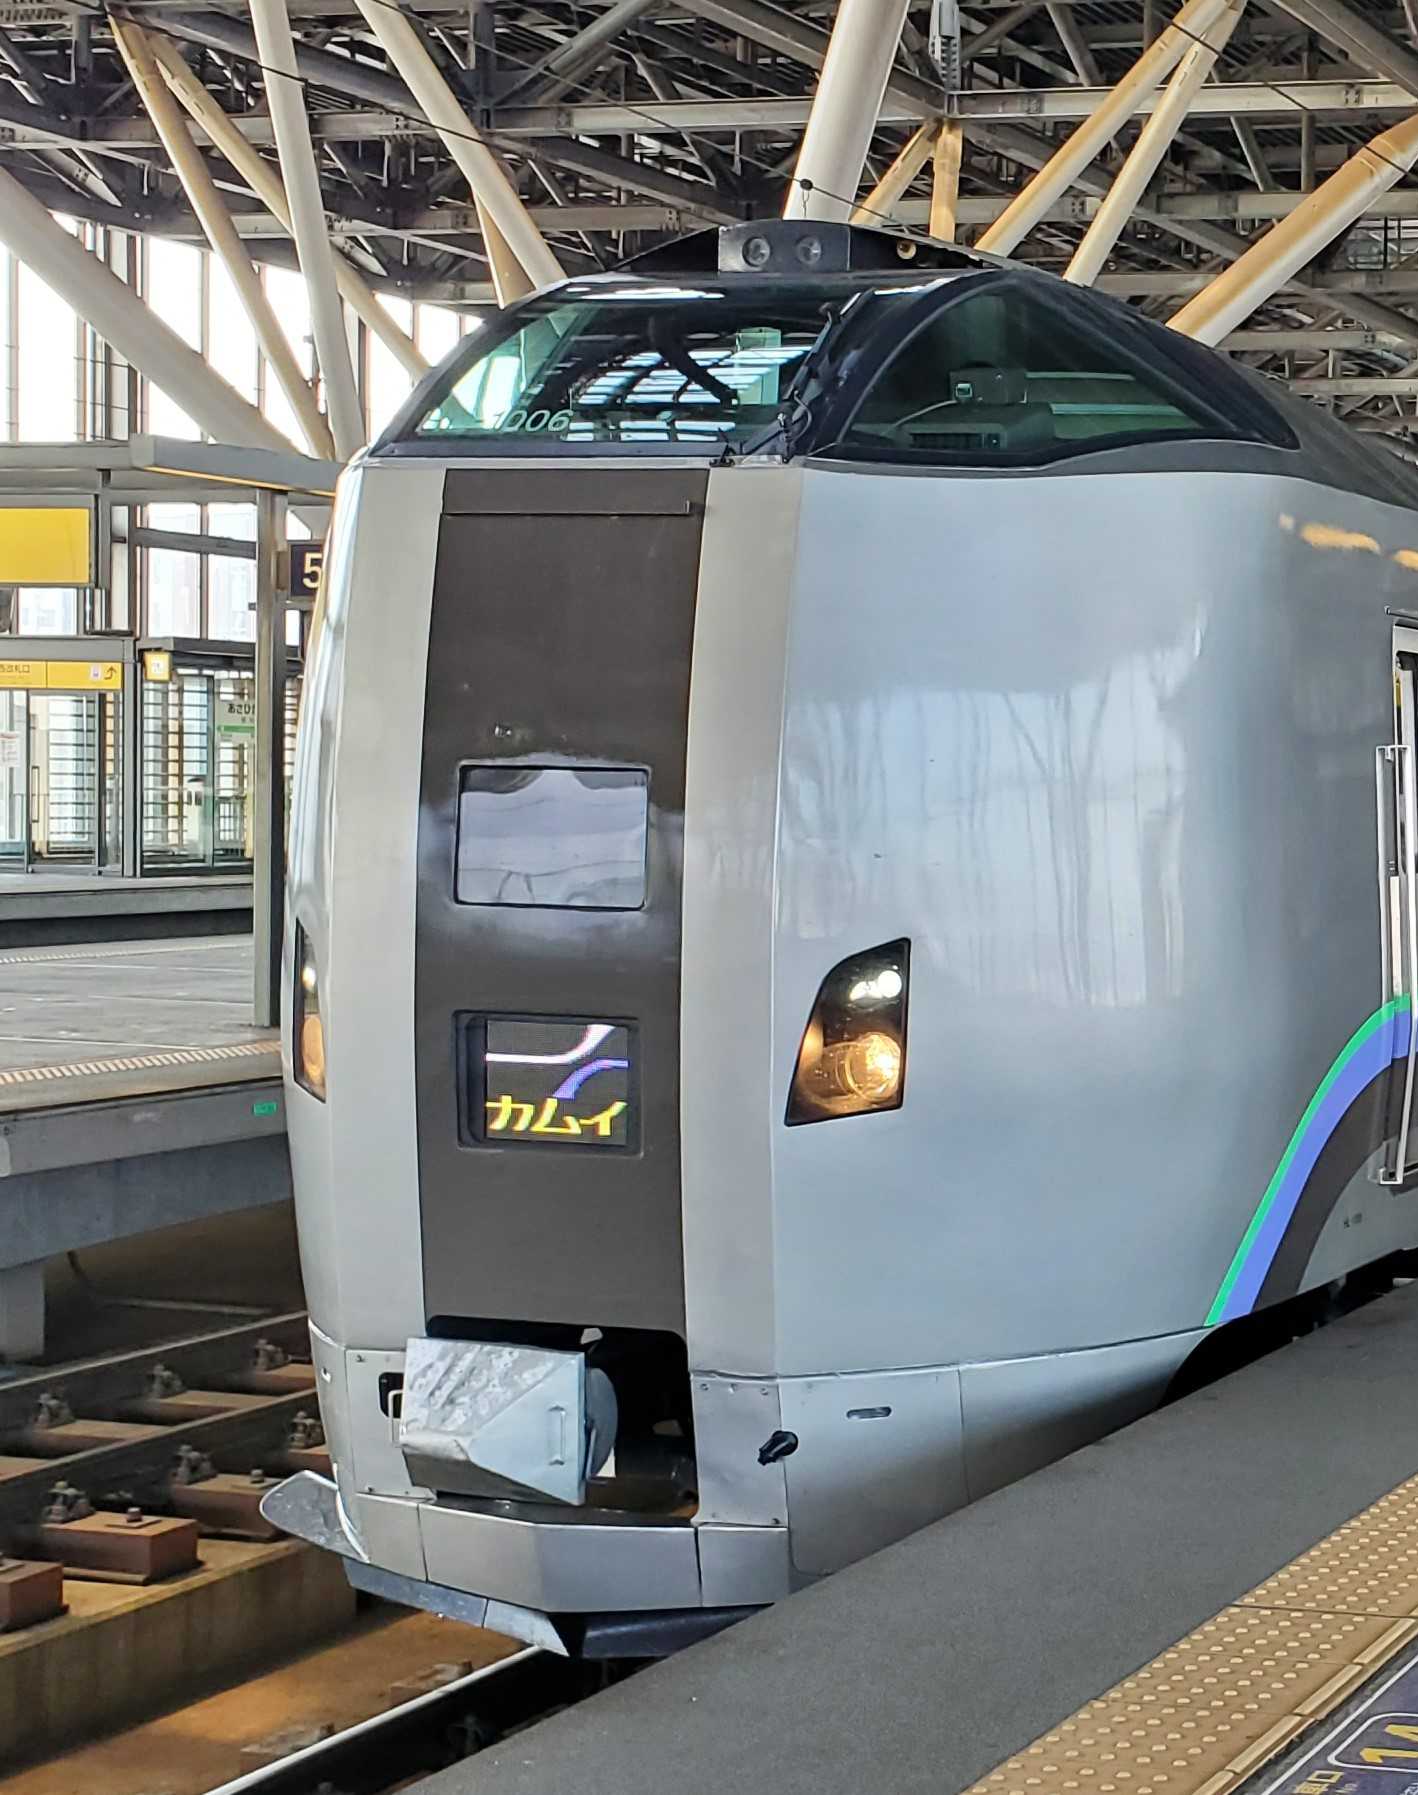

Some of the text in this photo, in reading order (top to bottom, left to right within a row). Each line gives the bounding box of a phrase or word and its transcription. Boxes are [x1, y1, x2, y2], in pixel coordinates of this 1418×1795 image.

[303, 552, 322, 589] 5
[486, 1095, 628, 1136] カムイ
